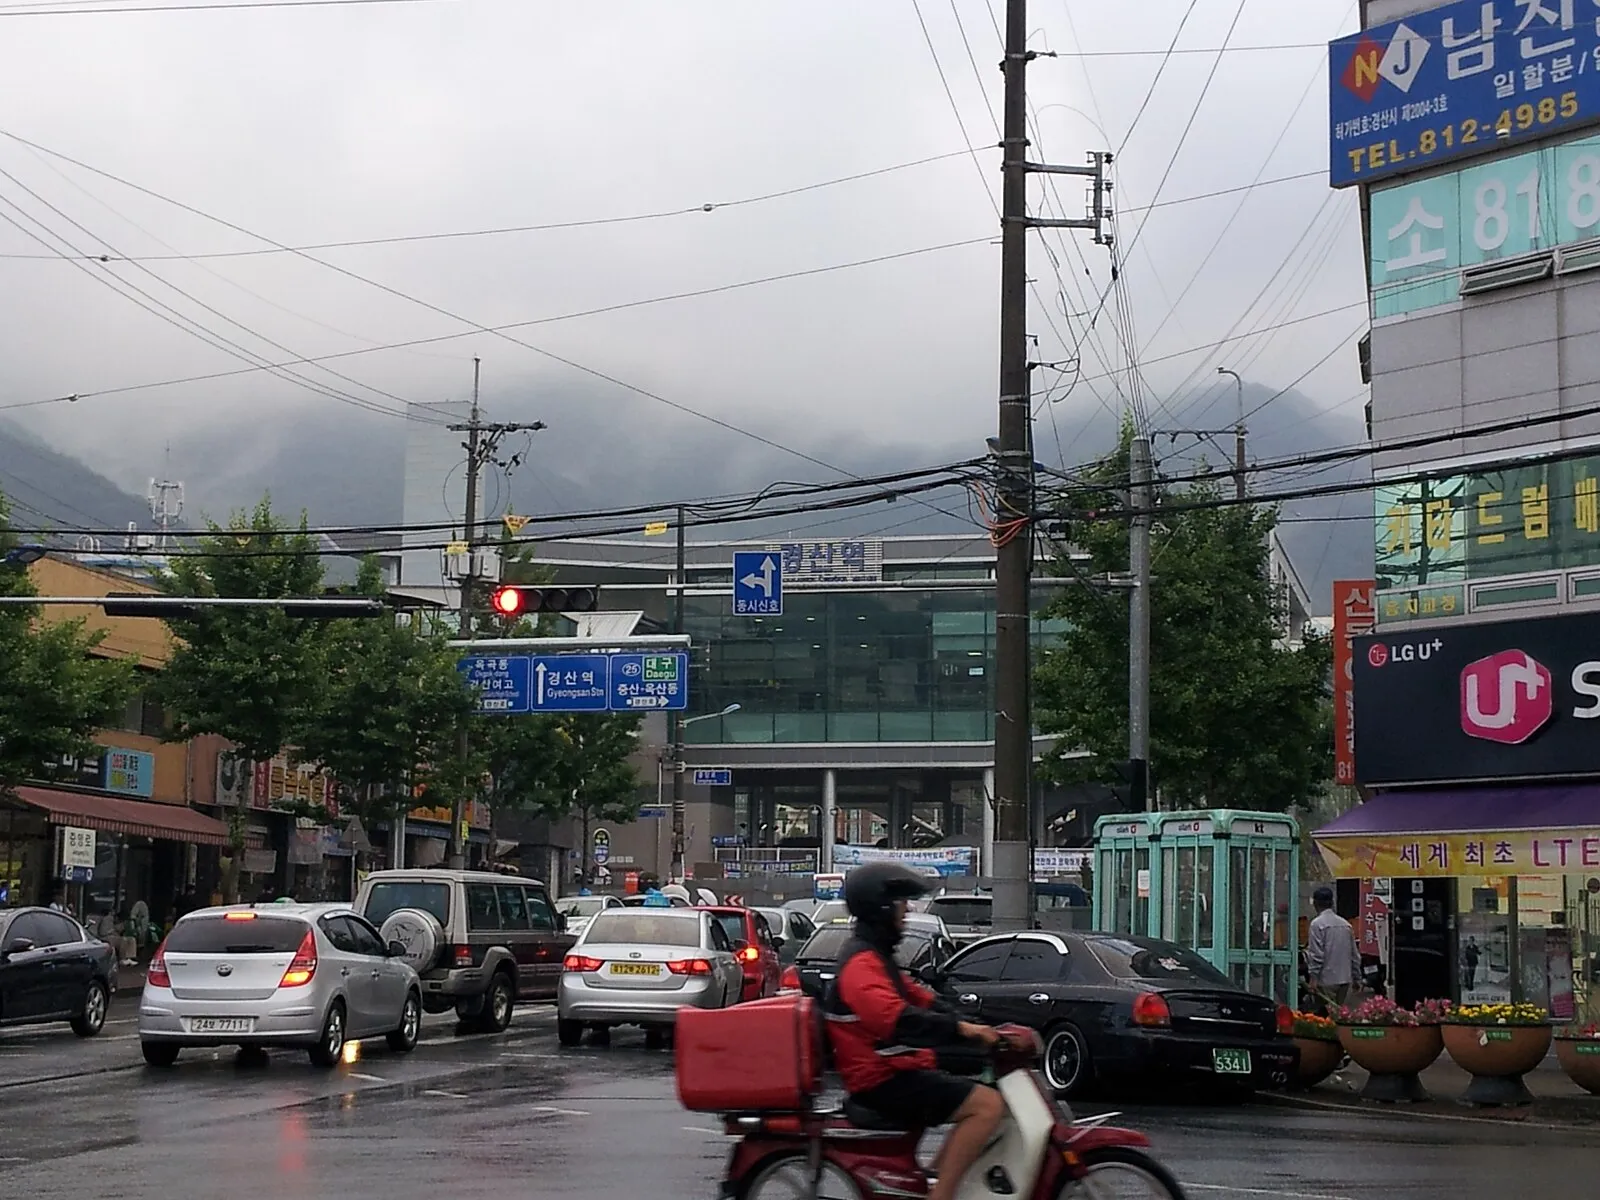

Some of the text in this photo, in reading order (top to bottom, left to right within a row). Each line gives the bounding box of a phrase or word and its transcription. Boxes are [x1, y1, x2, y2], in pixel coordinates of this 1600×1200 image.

[1442, 0, 1600, 80] 남진
[1385, 197, 1447, 271] 소
[737, 601, 779, 612] 동시신호
[1391, 638, 1443, 662] LG U+
[475, 659, 508, 671] 옥곡동
[626, 664, 637, 674] 25
[646, 658, 673, 669] 대구
[549, 671, 593, 685] 경산역
[646, 670, 675, 679] Daegu
[547, 688, 589, 698] Gyeongsan
[1254, 823, 1265, 834] kt
[1400, 838, 1600, 868] 세계 최초 LTE
[220, 1019, 243, 1029] 7711
[1216, 1056, 1247, 1071] 5341
